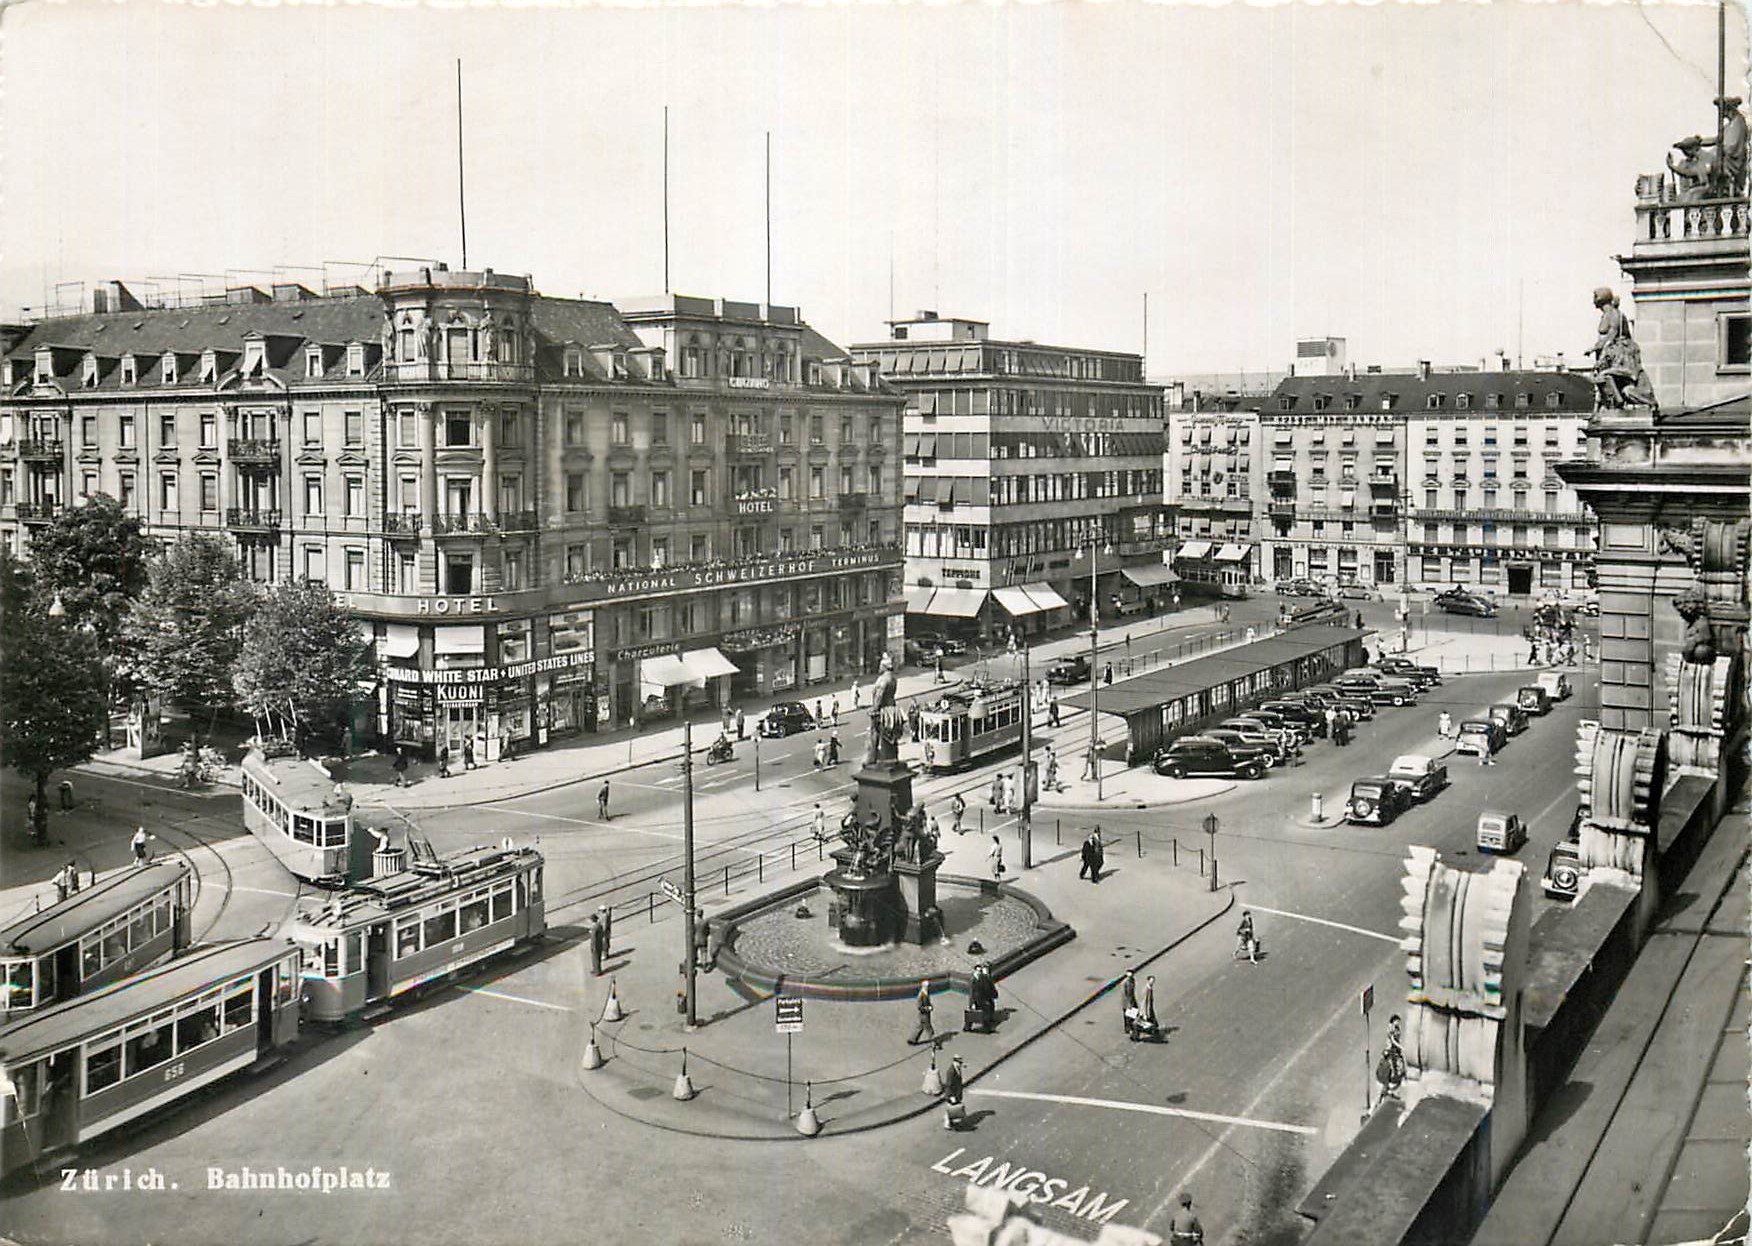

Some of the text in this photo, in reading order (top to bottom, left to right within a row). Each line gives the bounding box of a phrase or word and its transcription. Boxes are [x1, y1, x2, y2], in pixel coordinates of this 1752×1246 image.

[1042, 417, 1124, 431] VICTORIA
[738, 501, 773, 514] HOTEL
[607, 553, 880, 594] NATIONAL SCHWEIZERHOF TERMINUS
[417, 598, 499, 613] HOTEL
[422, 669, 463, 683] WHITE
[466, 668, 498, 681] STAR
[507, 661, 536, 679] UNITED
[537, 656, 568, 673] STATES
[570, 651, 595, 667] LINES
[437, 684, 484, 701] KUONI
[930, 1147, 1131, 1225] LANGSAM
